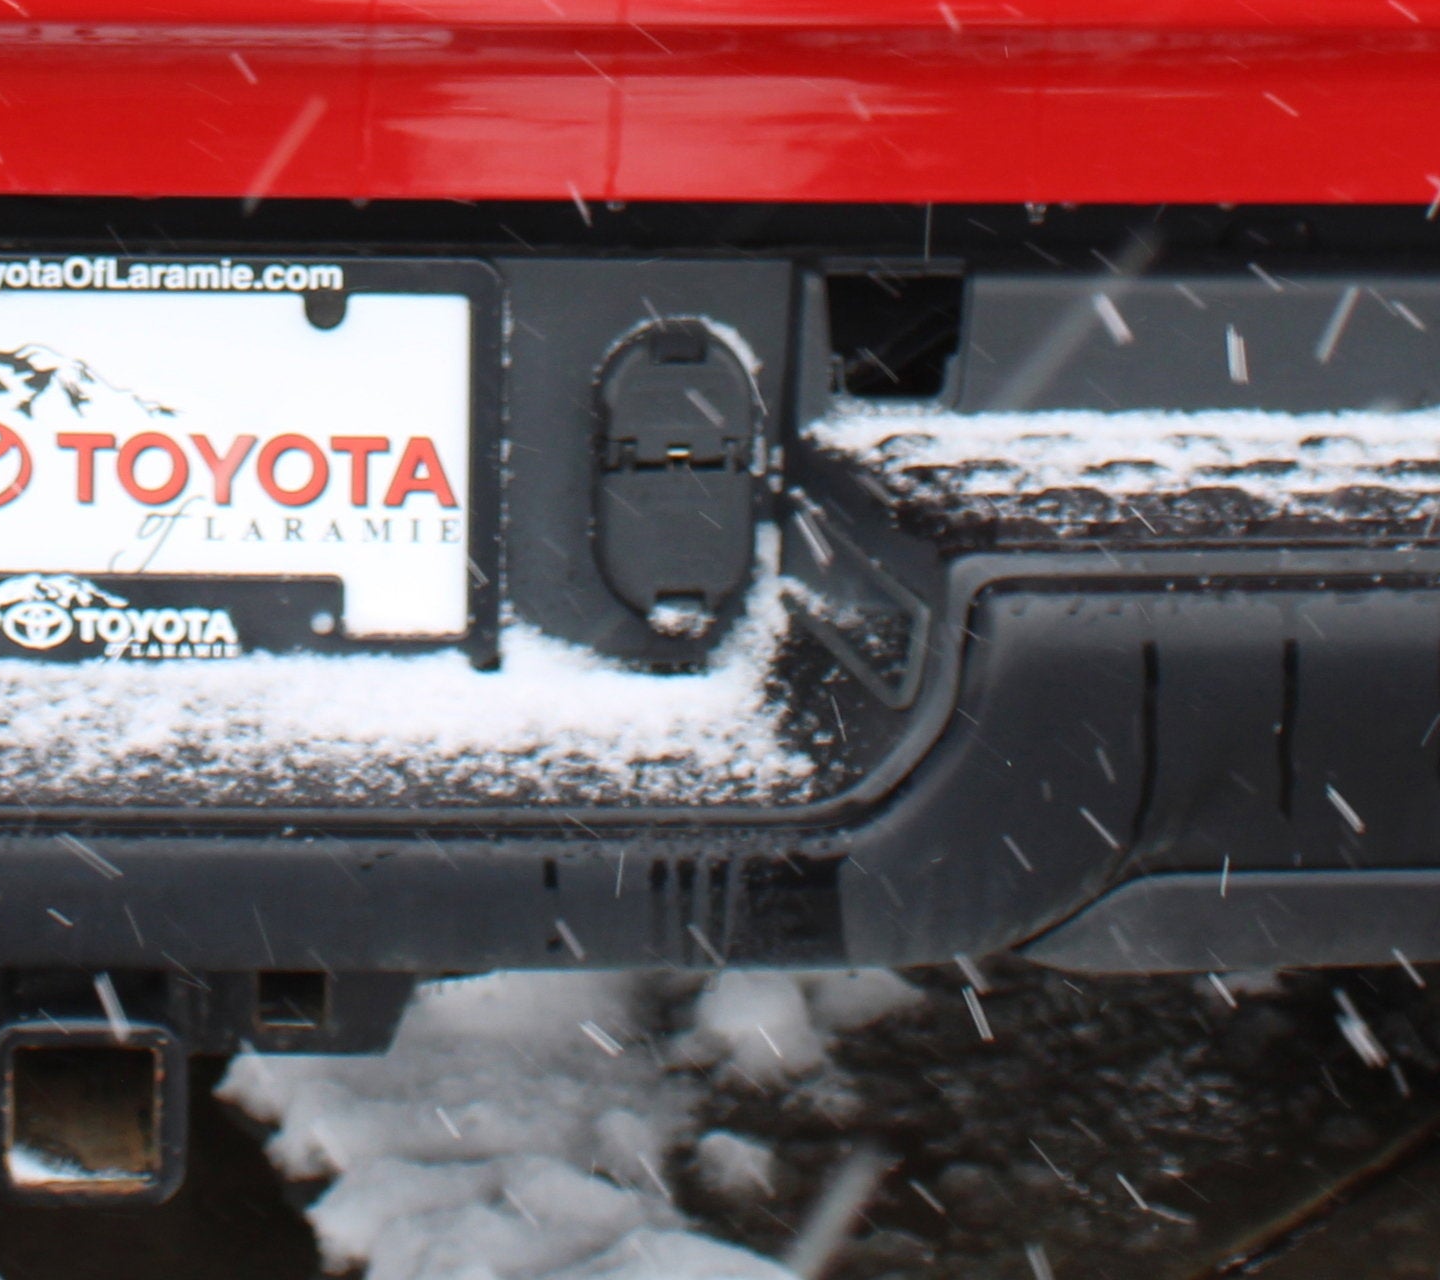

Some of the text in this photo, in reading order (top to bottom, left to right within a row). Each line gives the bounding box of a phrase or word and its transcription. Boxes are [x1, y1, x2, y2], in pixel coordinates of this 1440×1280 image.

[56, 431, 462, 509] TOYOTA
[107, 494, 464, 573] of LARAMIE
[71, 607, 239, 644] TOYOTA
